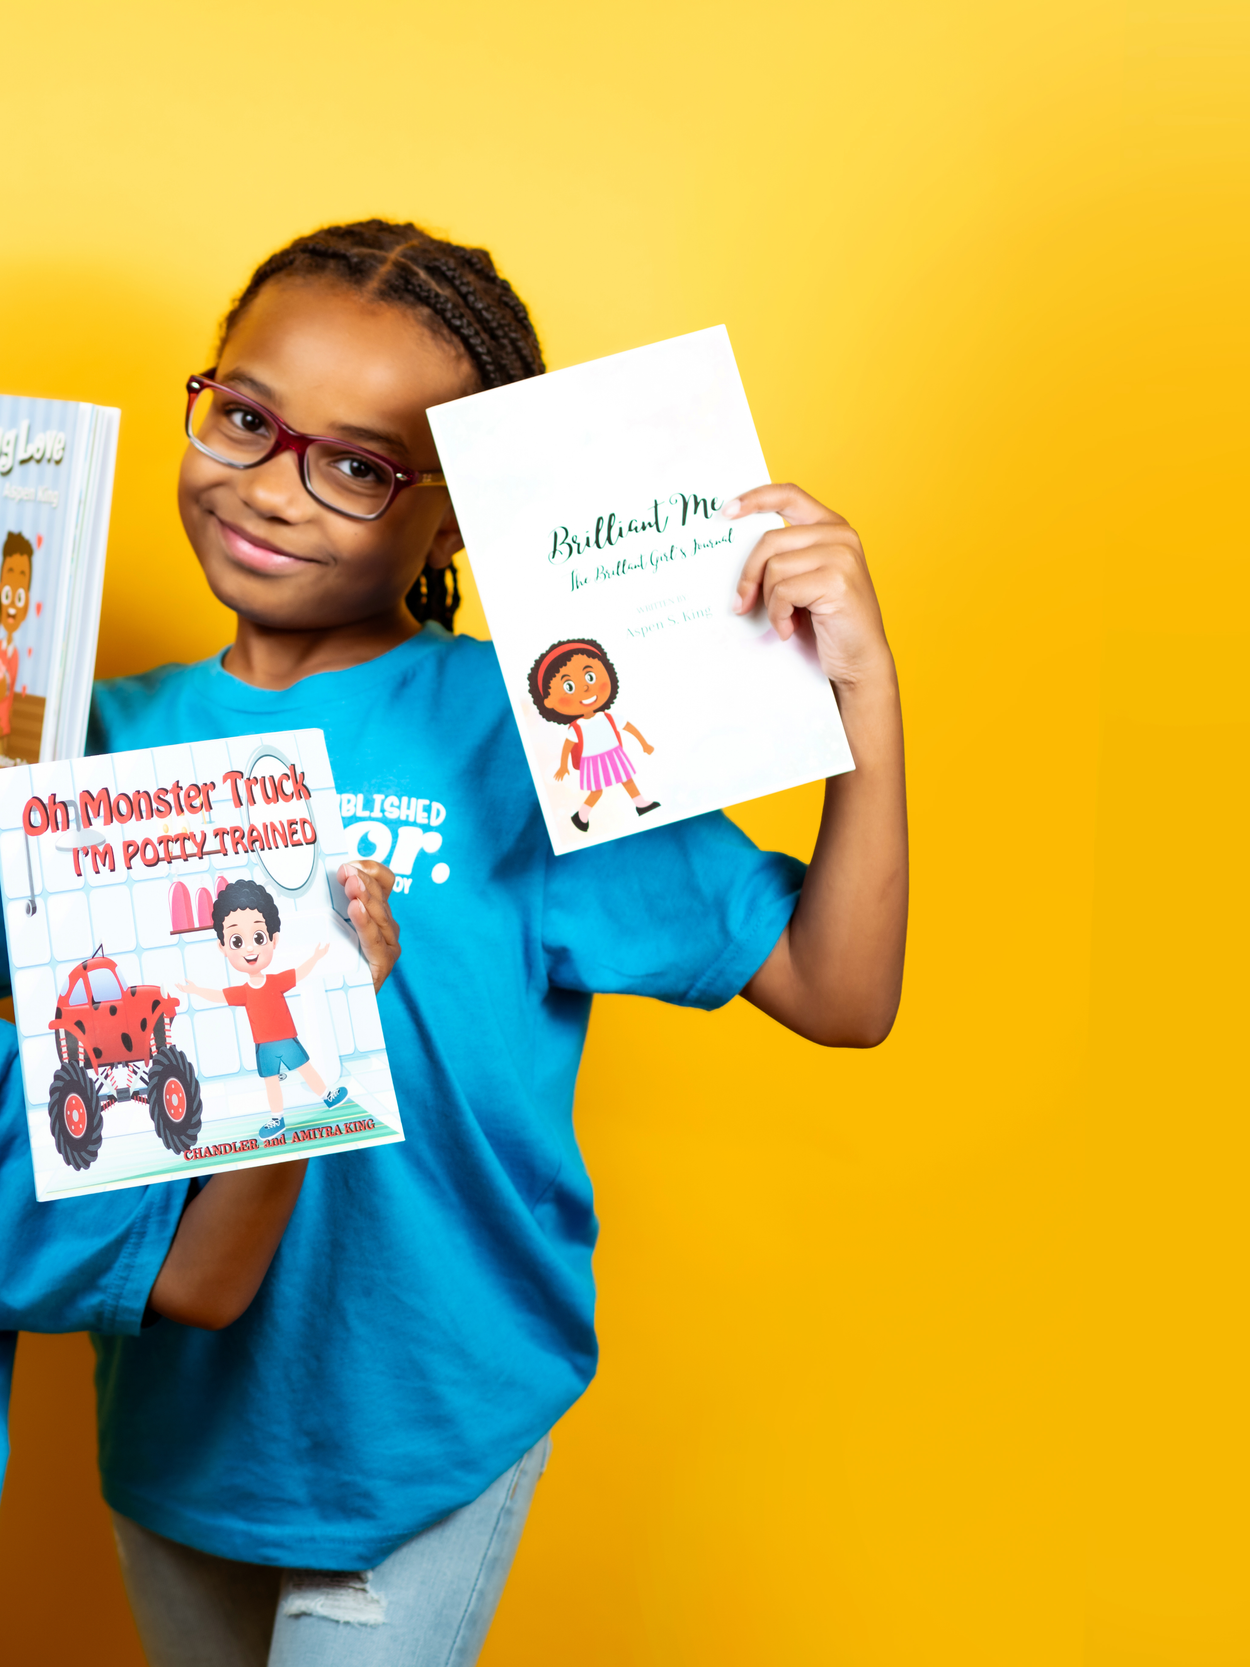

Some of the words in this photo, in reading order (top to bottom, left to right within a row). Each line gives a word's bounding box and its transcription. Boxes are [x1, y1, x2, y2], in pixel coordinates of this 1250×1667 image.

[17, 418, 66, 465] Love
[3, 481, 35, 504] Aspen
[37, 485, 59, 509] King
[548, 499, 669, 565] Brilliant
[669, 492, 724, 526] Me
[562, 569, 589, 592] The
[691, 527, 735, 556] Journal
[626, 621, 664, 639] Aspen
[667, 614, 680, 627] S.
[682, 605, 713, 620] King
[636, 598, 675, 614] WRITTEN
[22, 793, 70, 836] Oh
[79, 780, 216, 828] Monster
[222, 764, 312, 808] Truck
[336, 793, 447, 827] BLISHED
[72, 842, 115, 876] I'M
[122, 830, 206, 870] POTTY
[213, 817, 317, 856] TRAINED
[393, 876, 413, 894] OY
[183, 1138, 260, 1161] CHANDLER
[263, 1134, 287, 1148] and
[291, 1124, 343, 1144] AMIYRA
[343, 1118, 376, 1135] KING
